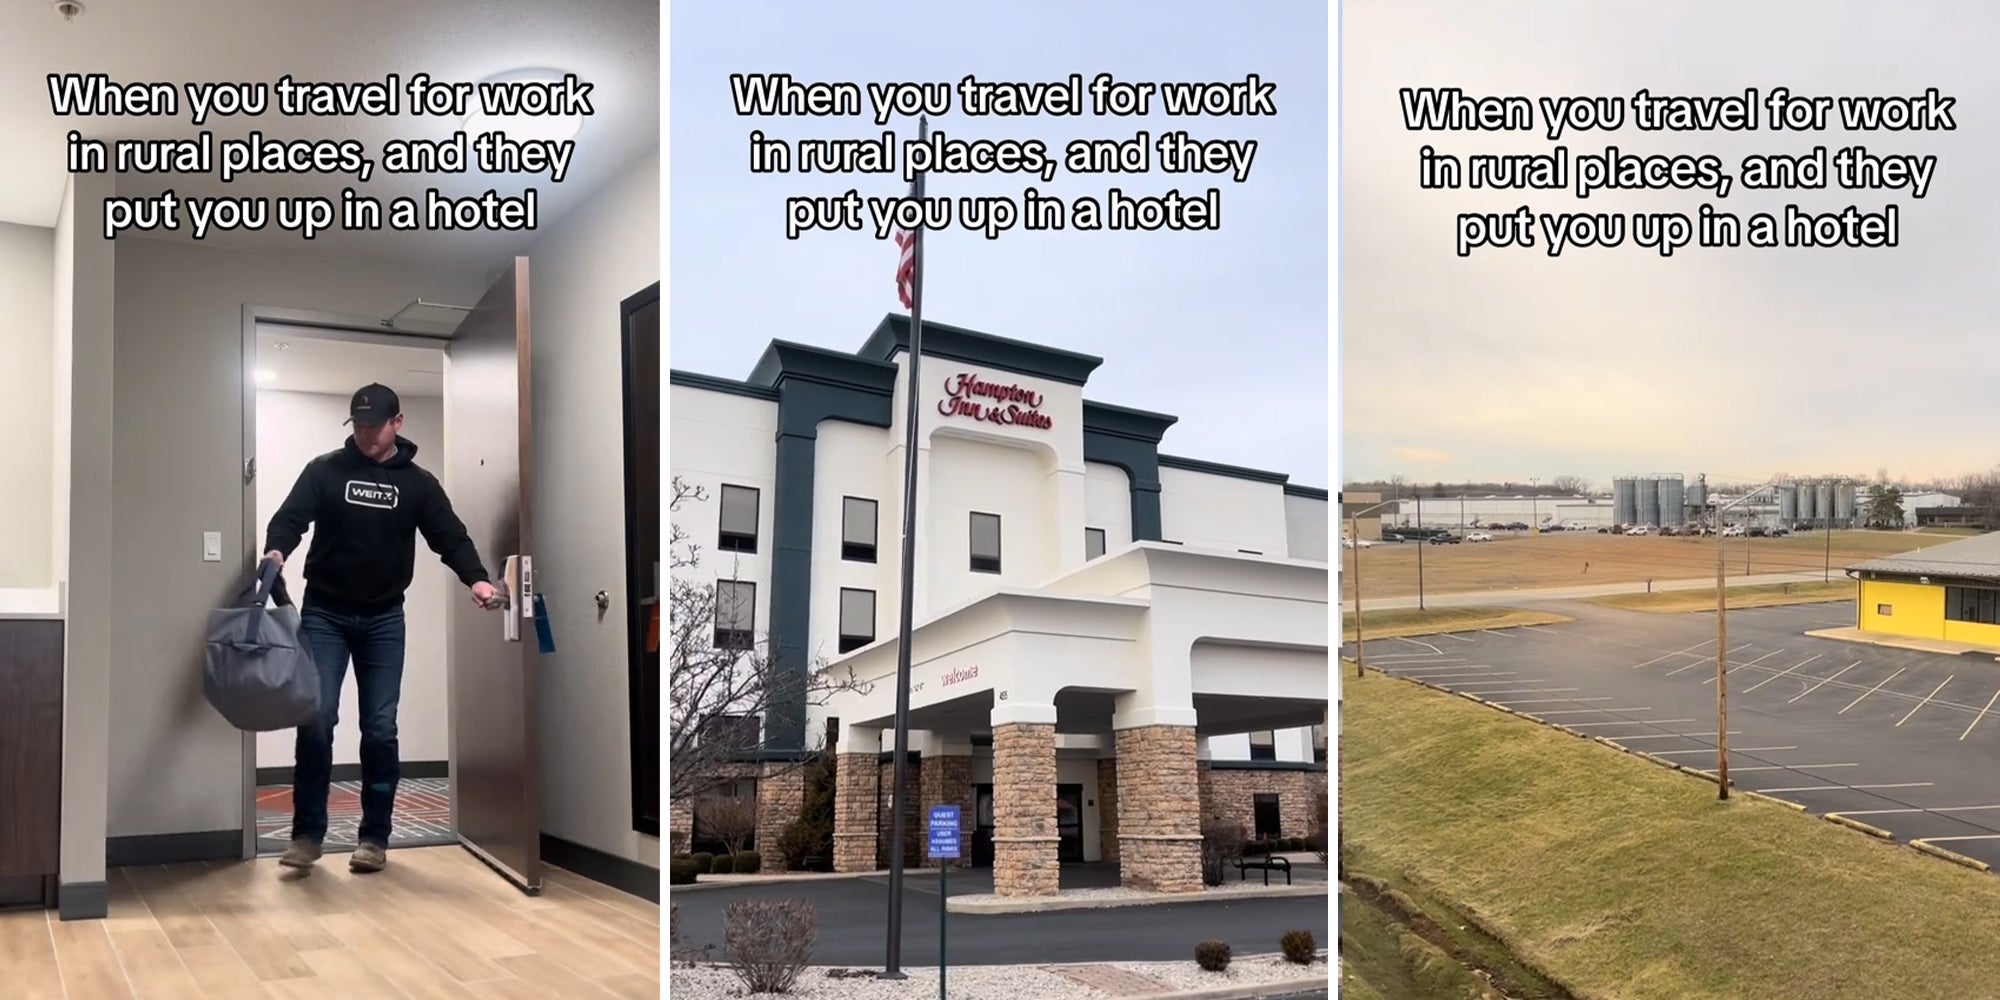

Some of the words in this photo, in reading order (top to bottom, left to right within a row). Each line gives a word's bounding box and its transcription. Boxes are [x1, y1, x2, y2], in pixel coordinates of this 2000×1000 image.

[944, 373, 1043, 409] Hampton
[937, 396, 990, 422] Inn
[987, 406, 1003, 426] &
[1000, 404, 1053, 430] Suites
[930, 819, 957, 827] PARKING
